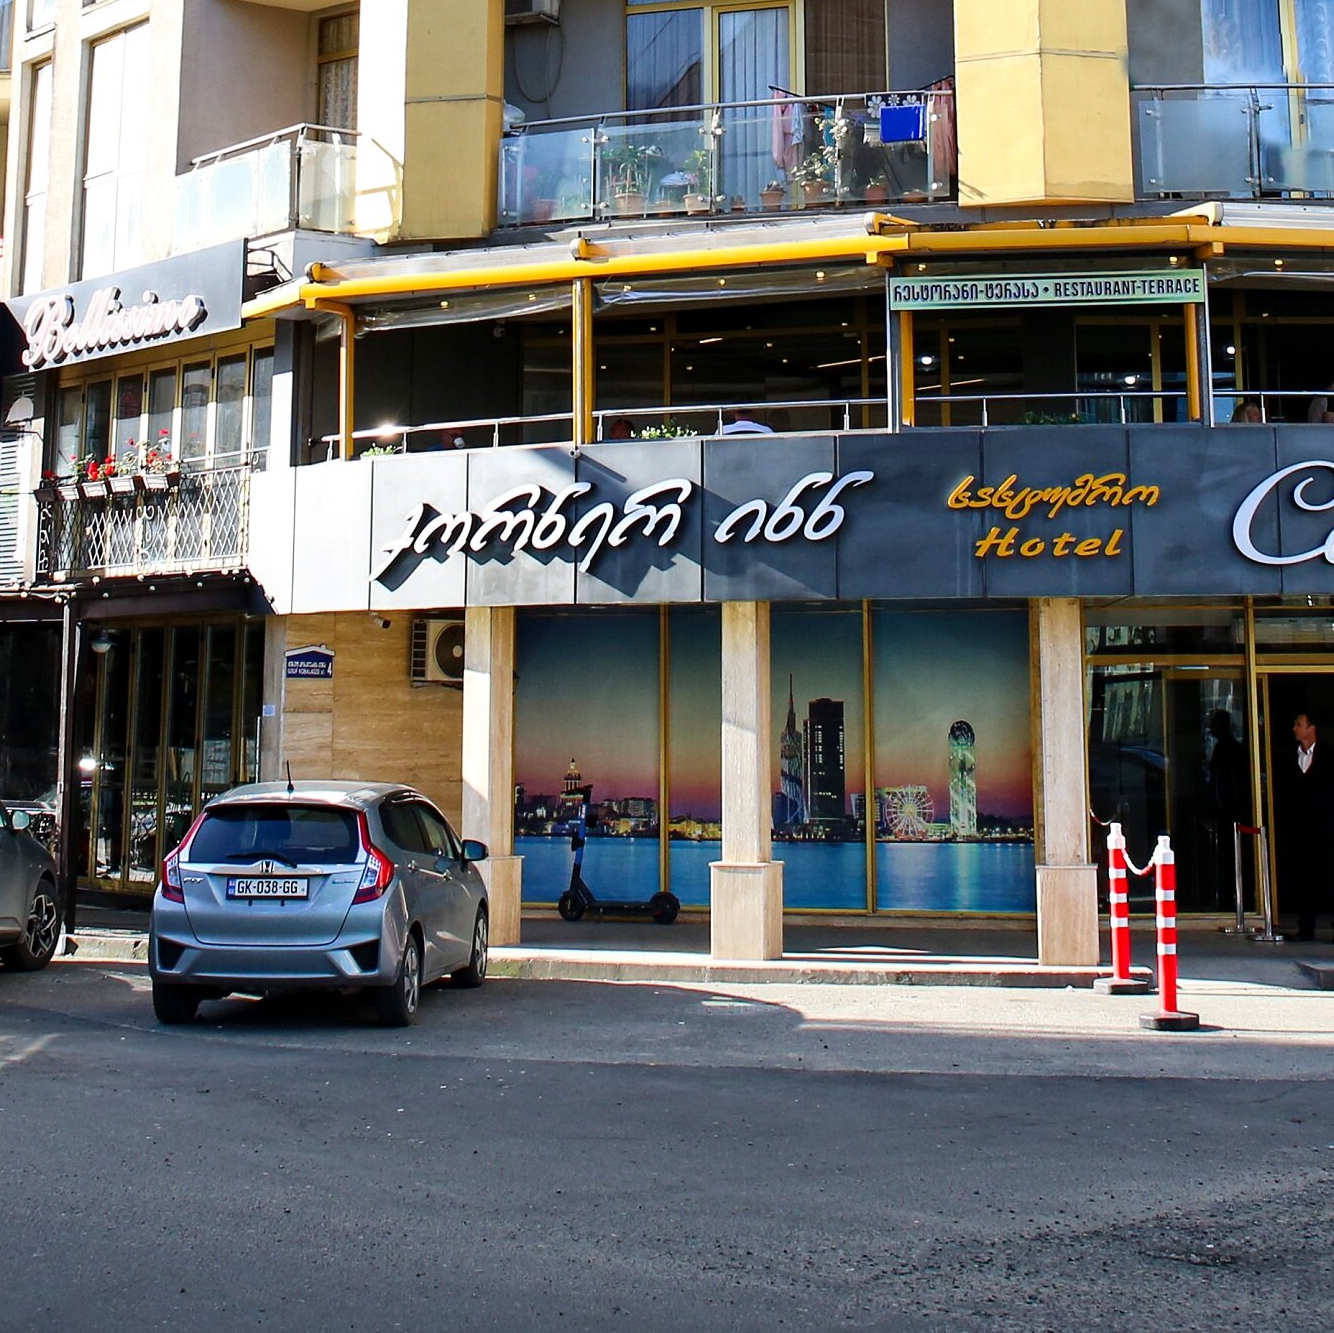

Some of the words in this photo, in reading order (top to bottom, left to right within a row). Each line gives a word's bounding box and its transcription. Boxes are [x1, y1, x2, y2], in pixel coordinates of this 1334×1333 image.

[893, 280, 1039, 303] რესტორანი-ტერასა
[1054, 278, 1200, 298] RESTAURANT-TERRACE
[22, 287, 207, 368] Bellissimo
[714, 471, 875, 542] ინნ
[947, 473, 1161, 519] სასტუმრო
[974, 526, 1124, 558] Hotel
[237, 880, 298, 895] GK-038-GG
